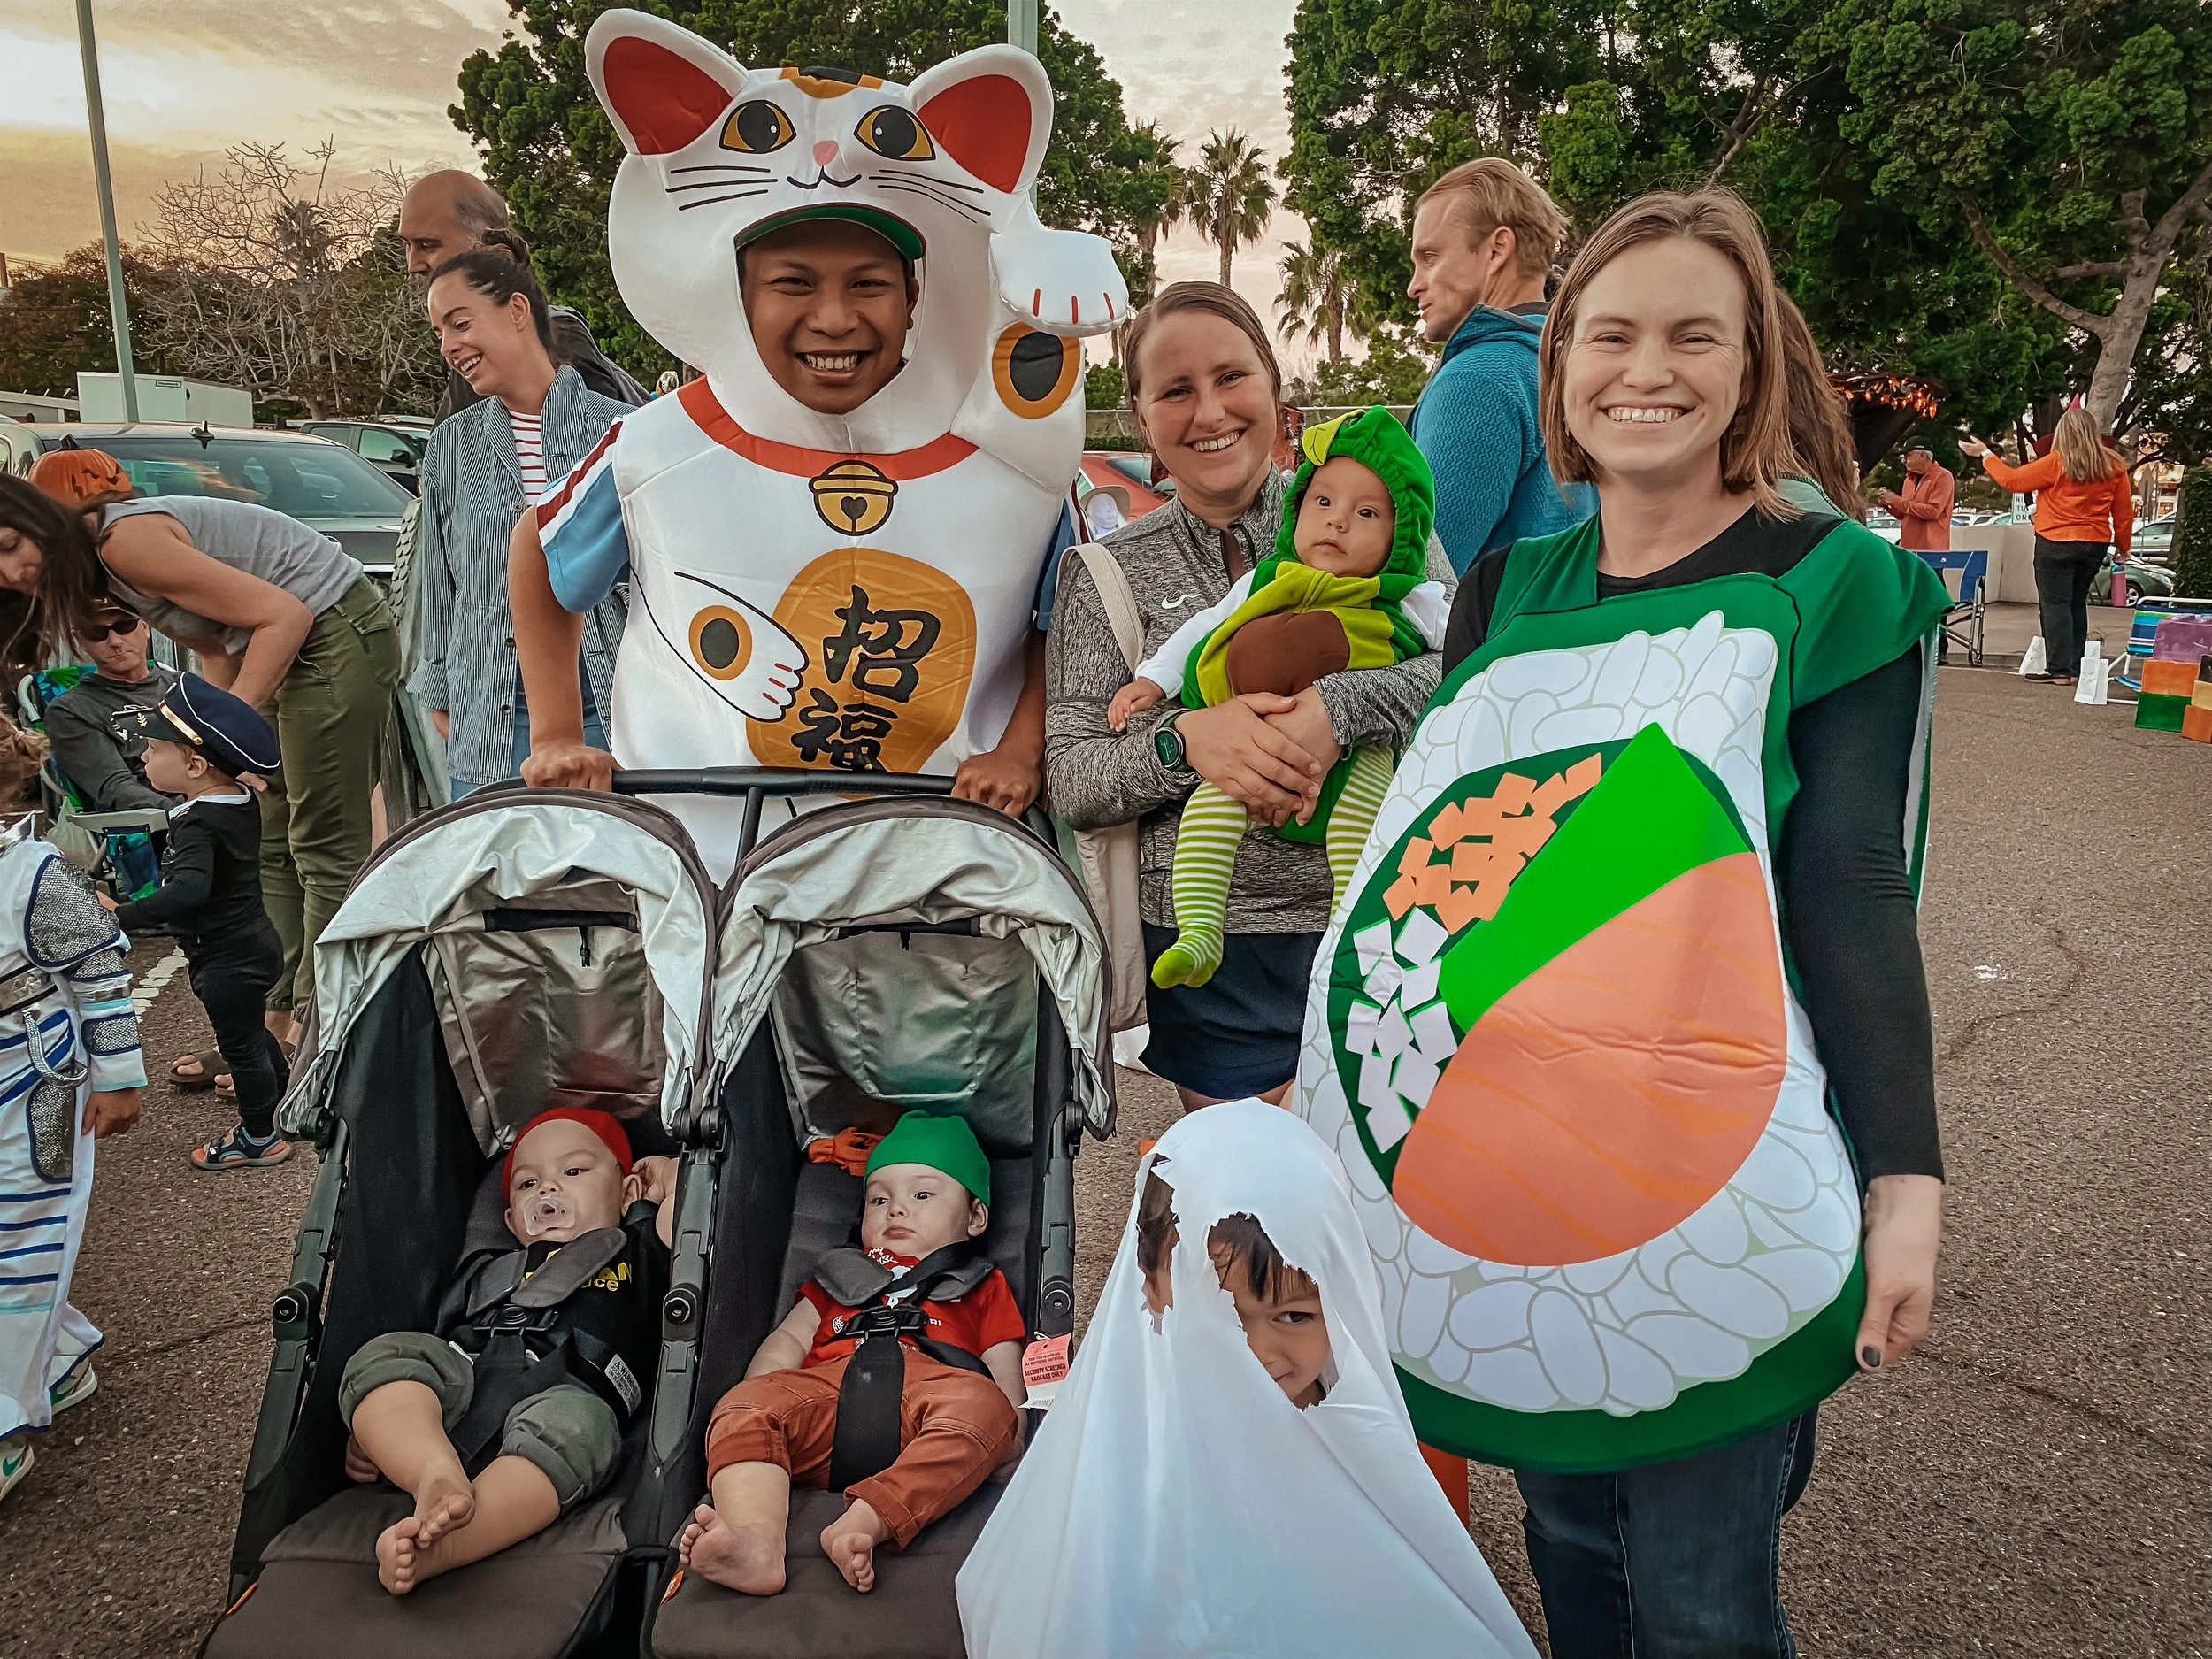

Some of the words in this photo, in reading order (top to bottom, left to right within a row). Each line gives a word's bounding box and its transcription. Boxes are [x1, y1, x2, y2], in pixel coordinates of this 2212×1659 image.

[790, 584, 941, 772] 招福
[1025, 1367, 1044, 1376] SECURITY
[1031, 1373, 1051, 1382] BAGGAGE
